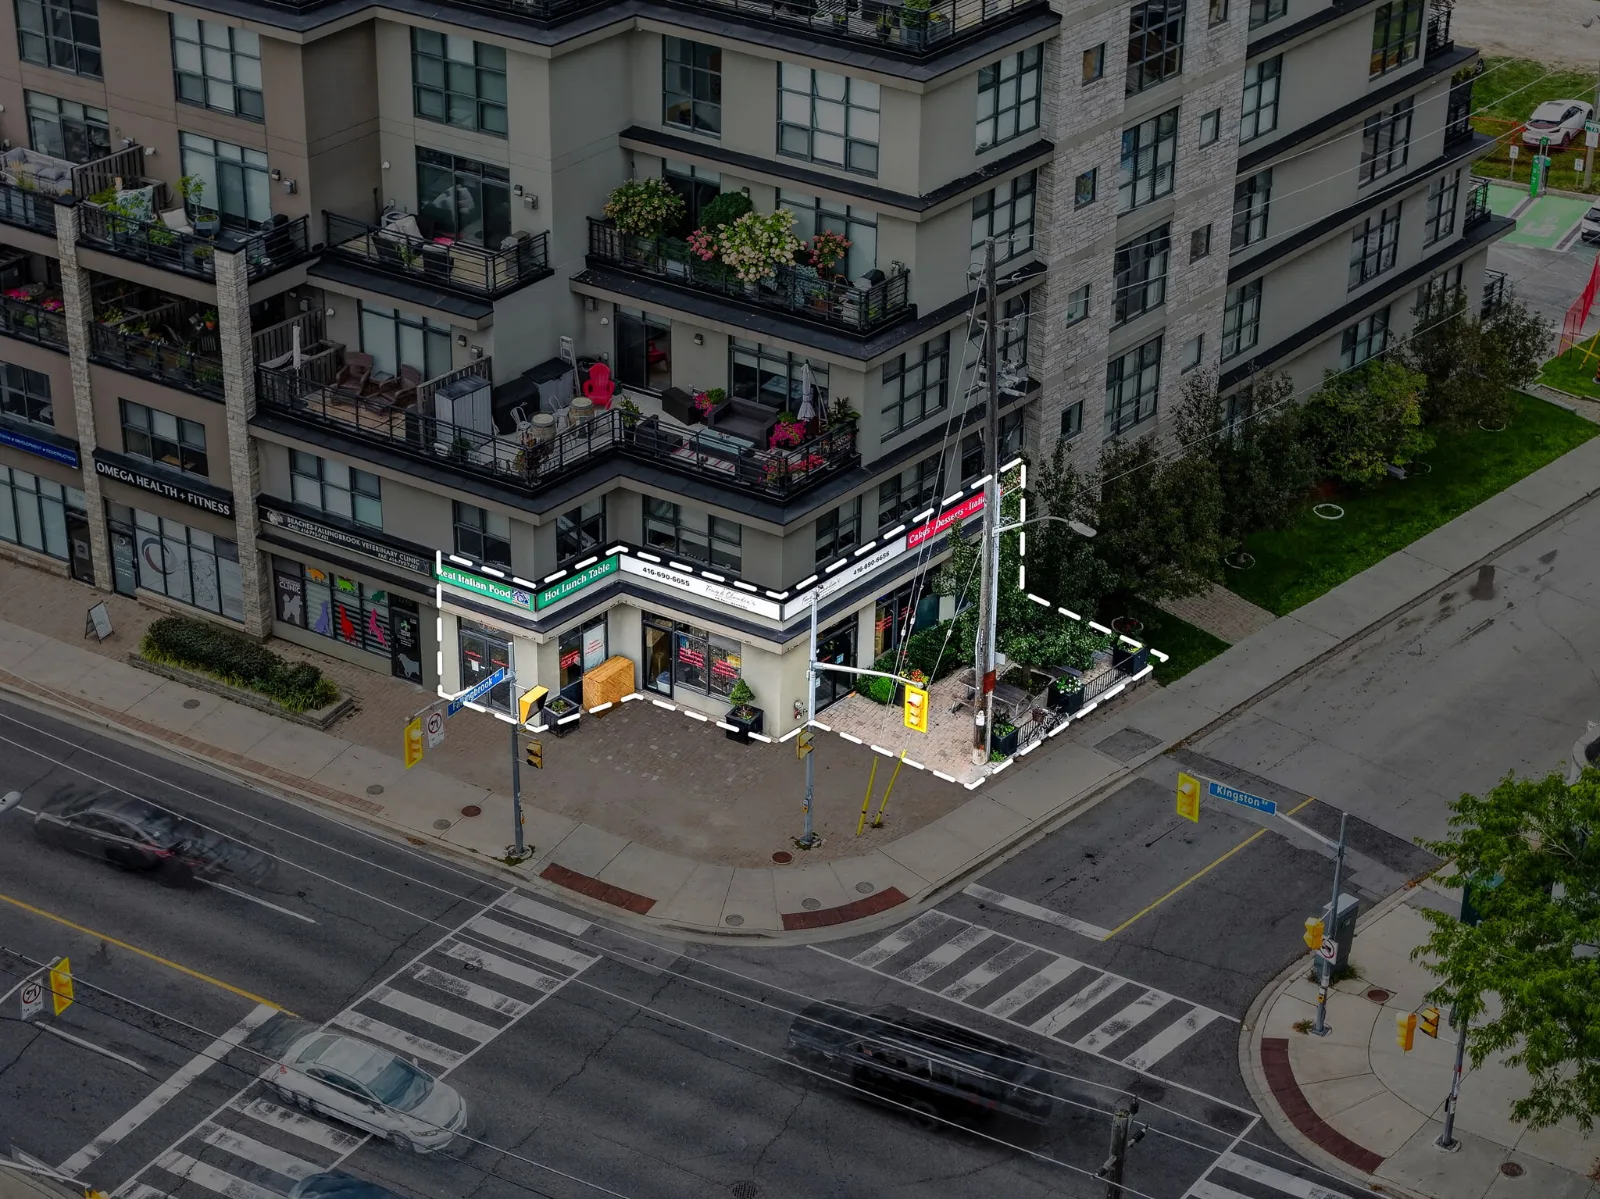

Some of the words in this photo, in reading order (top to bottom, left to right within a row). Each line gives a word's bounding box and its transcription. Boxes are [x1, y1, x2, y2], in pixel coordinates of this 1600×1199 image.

[96, 462, 135, 484] OMEGA
[136, 475, 178, 498] HEALTH
[179, 492, 186, 500] +
[187, 493, 231, 516] FITNESS
[909, 527, 930, 544] Cakes
[361, 540, 398, 558] VETERINARY
[399, 553, 420, 566] CLINIC
[279, 581, 301, 594] CLINIC
[439, 570, 456, 581] eal
[457, 573, 487, 591] Italian
[489, 584, 511, 599] Food
[544, 589, 560, 602] Hot
[561, 574, 587, 594] Lunch
[588, 563, 610, 579] Table
[1216, 785, 1260, 807] Kingston
